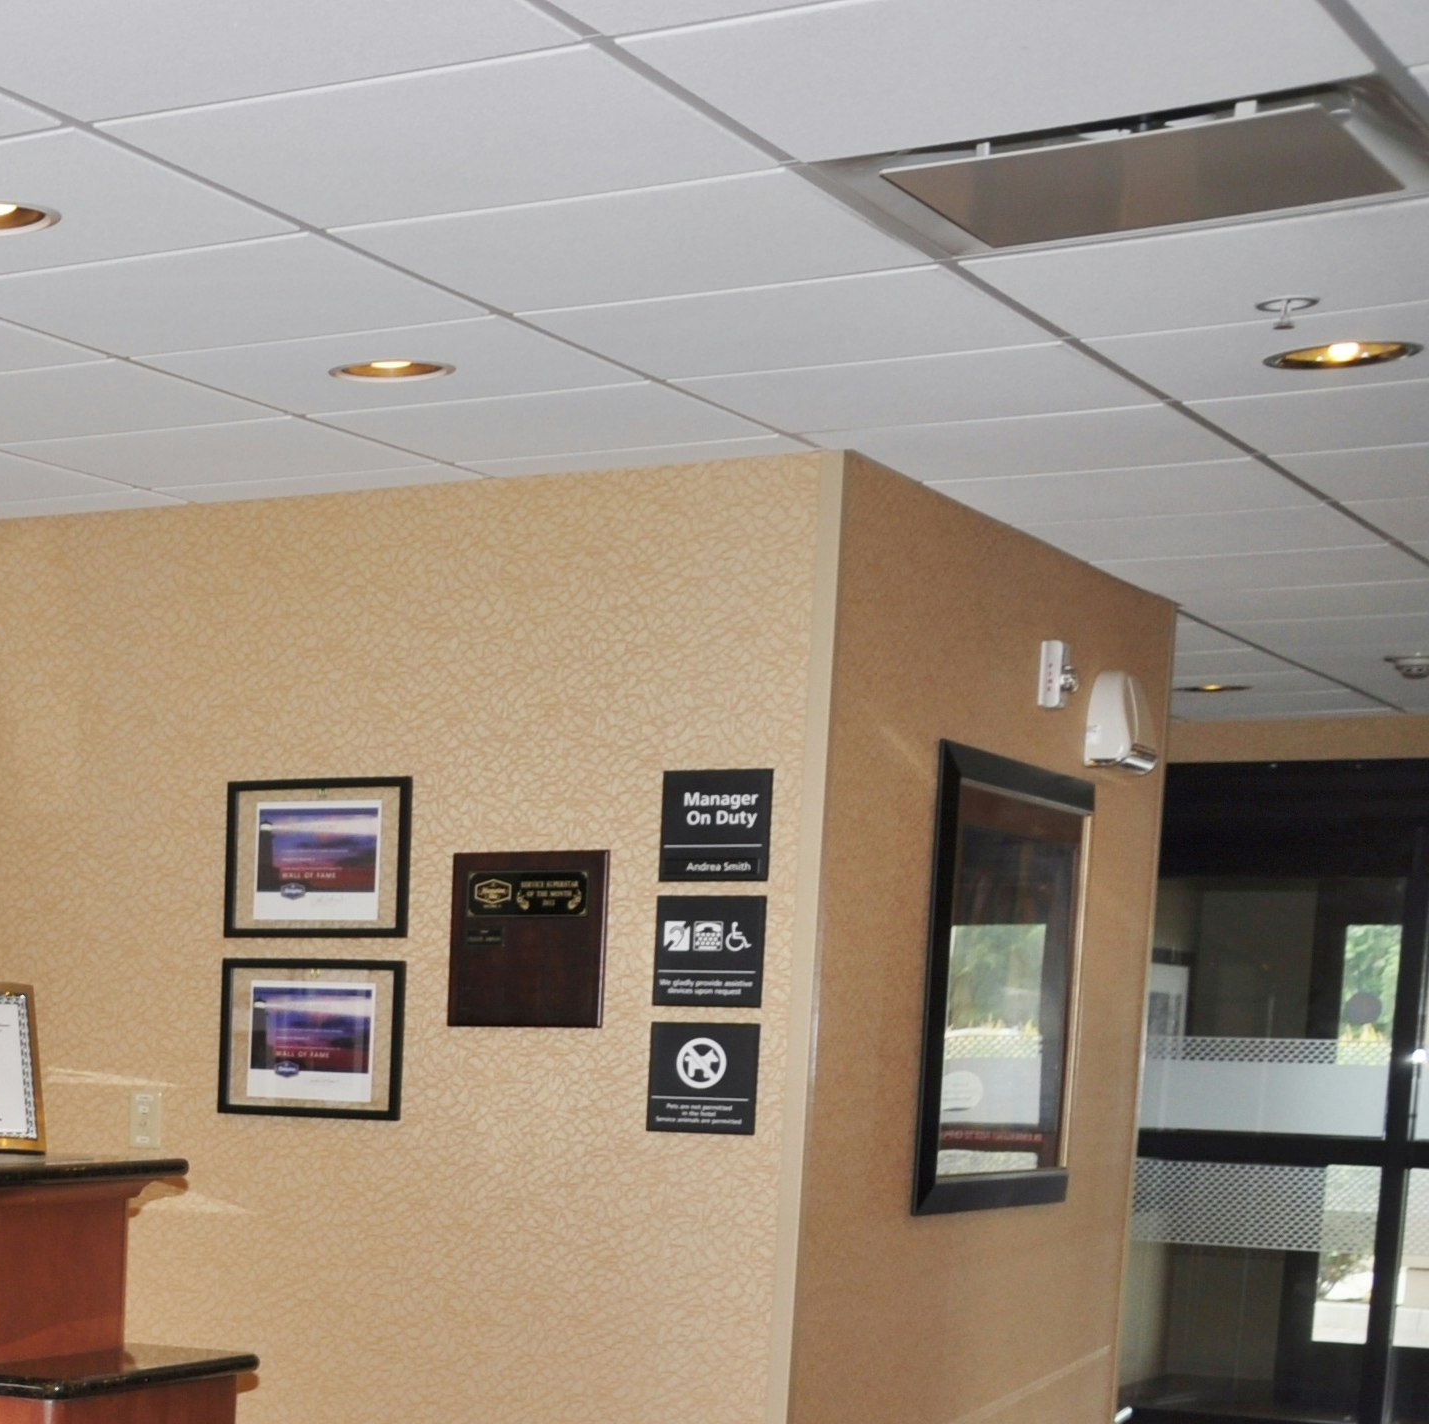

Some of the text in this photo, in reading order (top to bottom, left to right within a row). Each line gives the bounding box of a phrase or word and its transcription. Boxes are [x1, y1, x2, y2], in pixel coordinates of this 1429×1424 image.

[683, 791, 759, 810] Manager
[686, 810, 758, 828] On Duty
[686, 861, 752, 872] Andrea Smith
[672, 978, 694, 988] gladly
[695, 978, 723, 988] provide
[694, 988, 713, 996] upon
[714, 988, 741, 996] request
